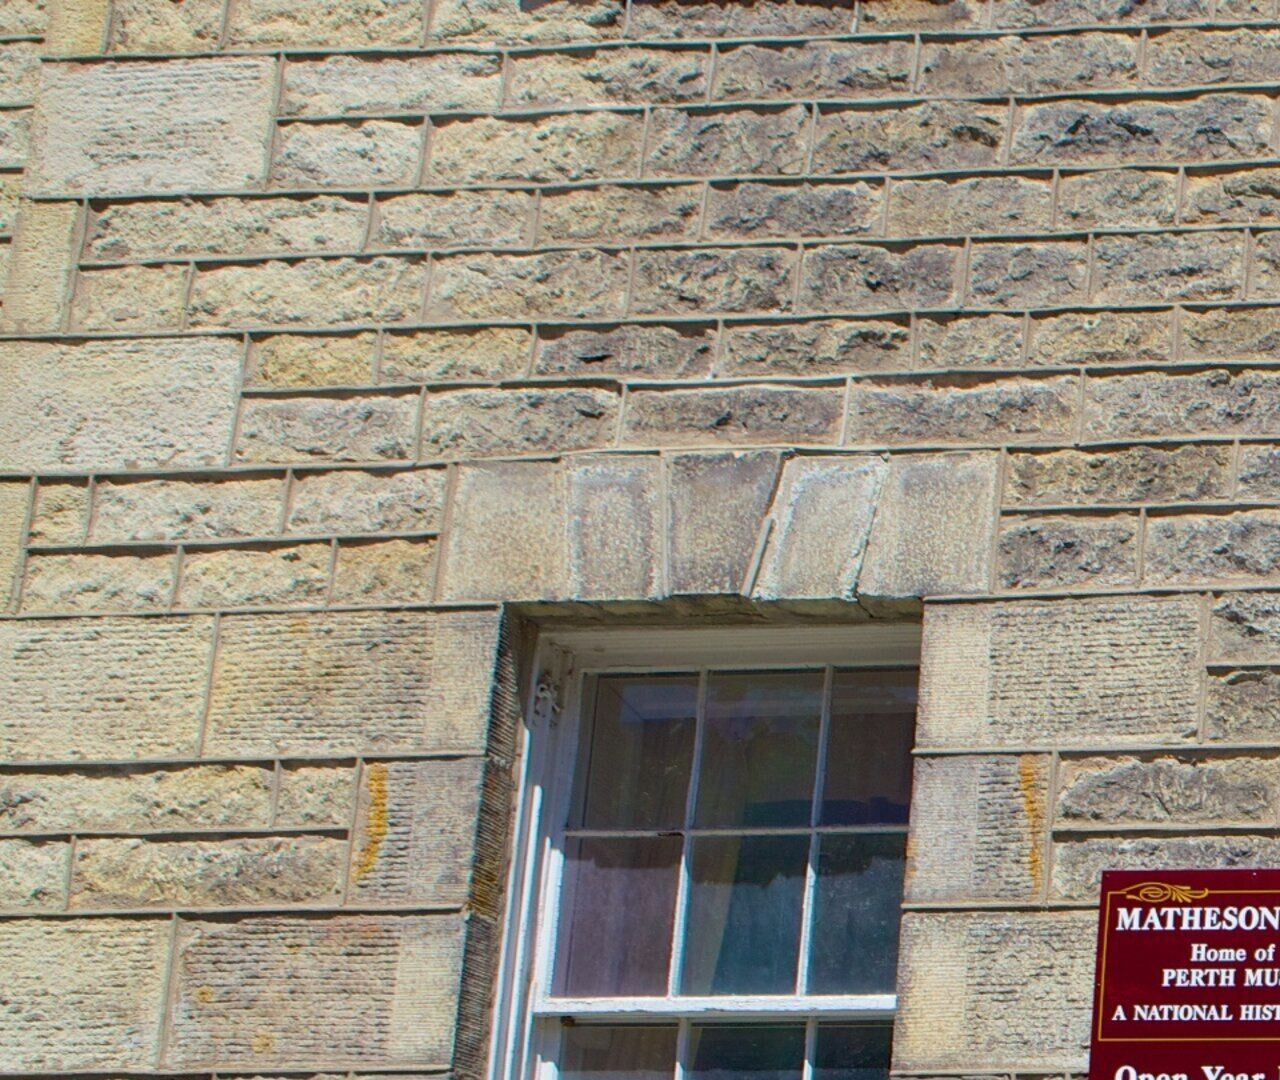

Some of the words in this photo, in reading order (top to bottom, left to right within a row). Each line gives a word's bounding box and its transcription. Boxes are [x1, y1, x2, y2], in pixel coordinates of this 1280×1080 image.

[1191, 944, 1246, 961] Home
[1255, 944, 1275, 961] of
[1162, 969, 1236, 986] PERTH
[1112, 1005, 1126, 1020] A
[1134, 1005, 1232, 1020] NATIONAL
